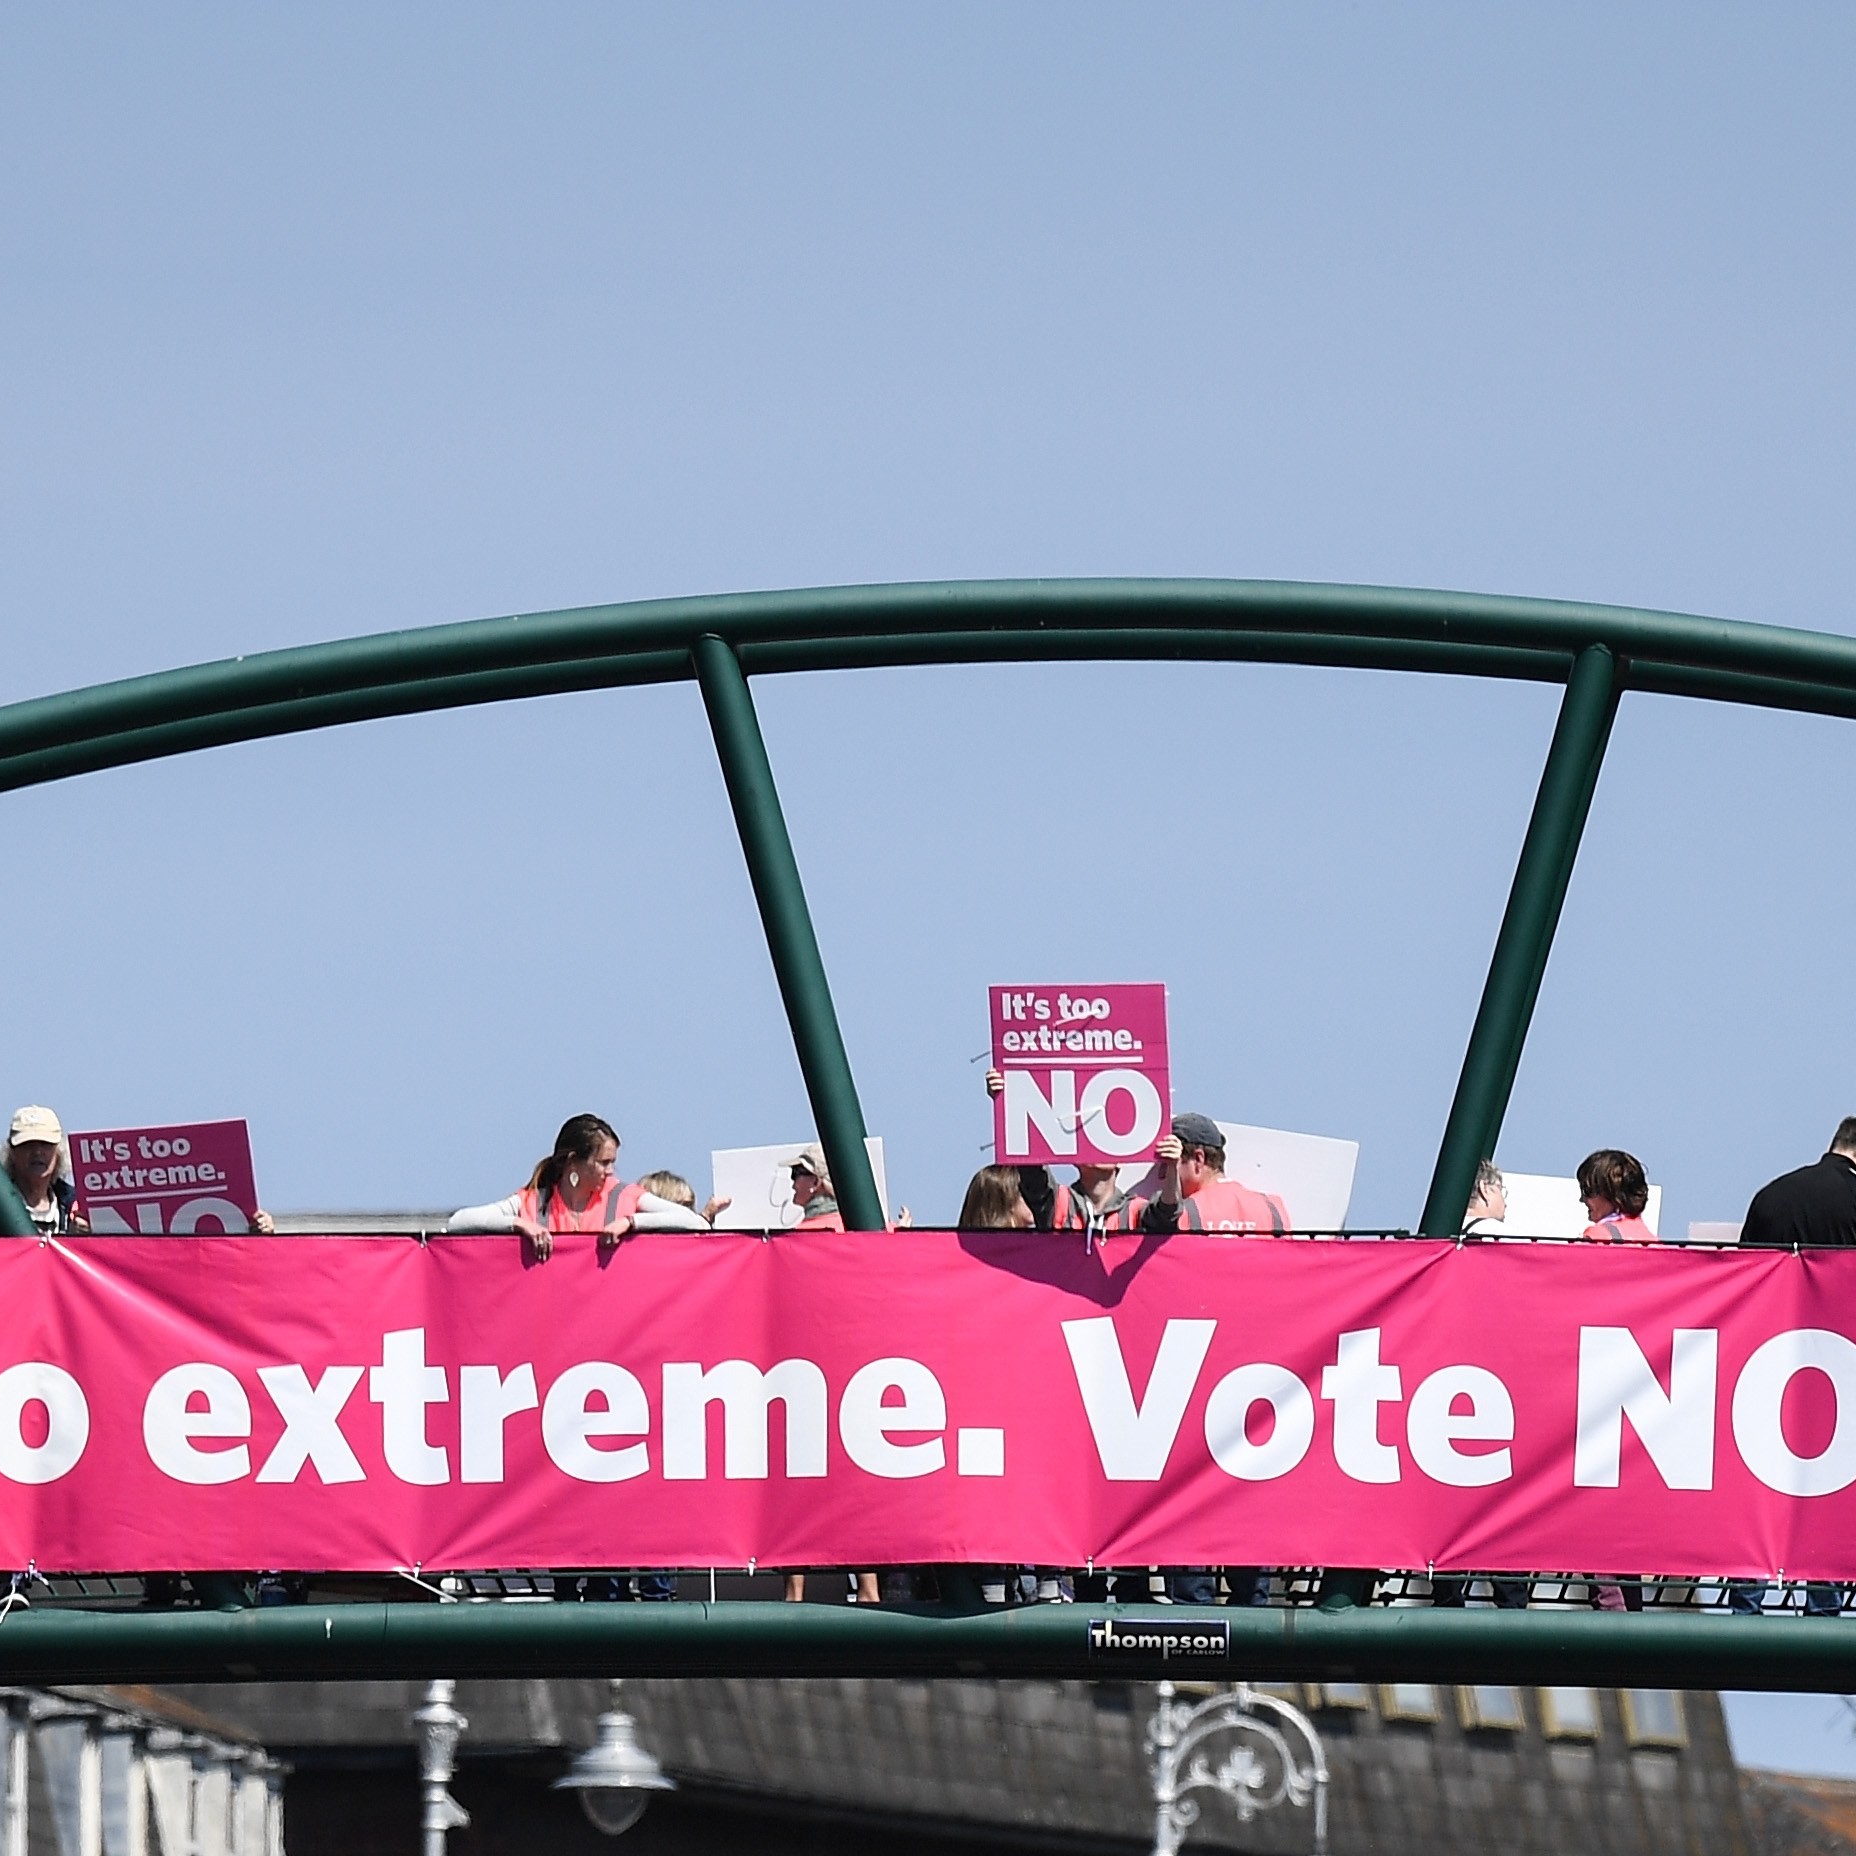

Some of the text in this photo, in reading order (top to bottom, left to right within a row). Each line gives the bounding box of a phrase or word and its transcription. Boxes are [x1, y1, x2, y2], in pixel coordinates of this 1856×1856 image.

[1002, 993, 1110, 1020] It's too
[1003, 1025, 1142, 1051] extreme.
[1004, 1068, 1162, 1157] NO
[79, 1134, 191, 1163] It's too
[84, 1162, 227, 1191] extreme.
[144, 1326, 1006, 1486] extreme.
[1061, 1315, 1516, 1488] Vote
[1091, 1619, 1225, 1660] Thompson
